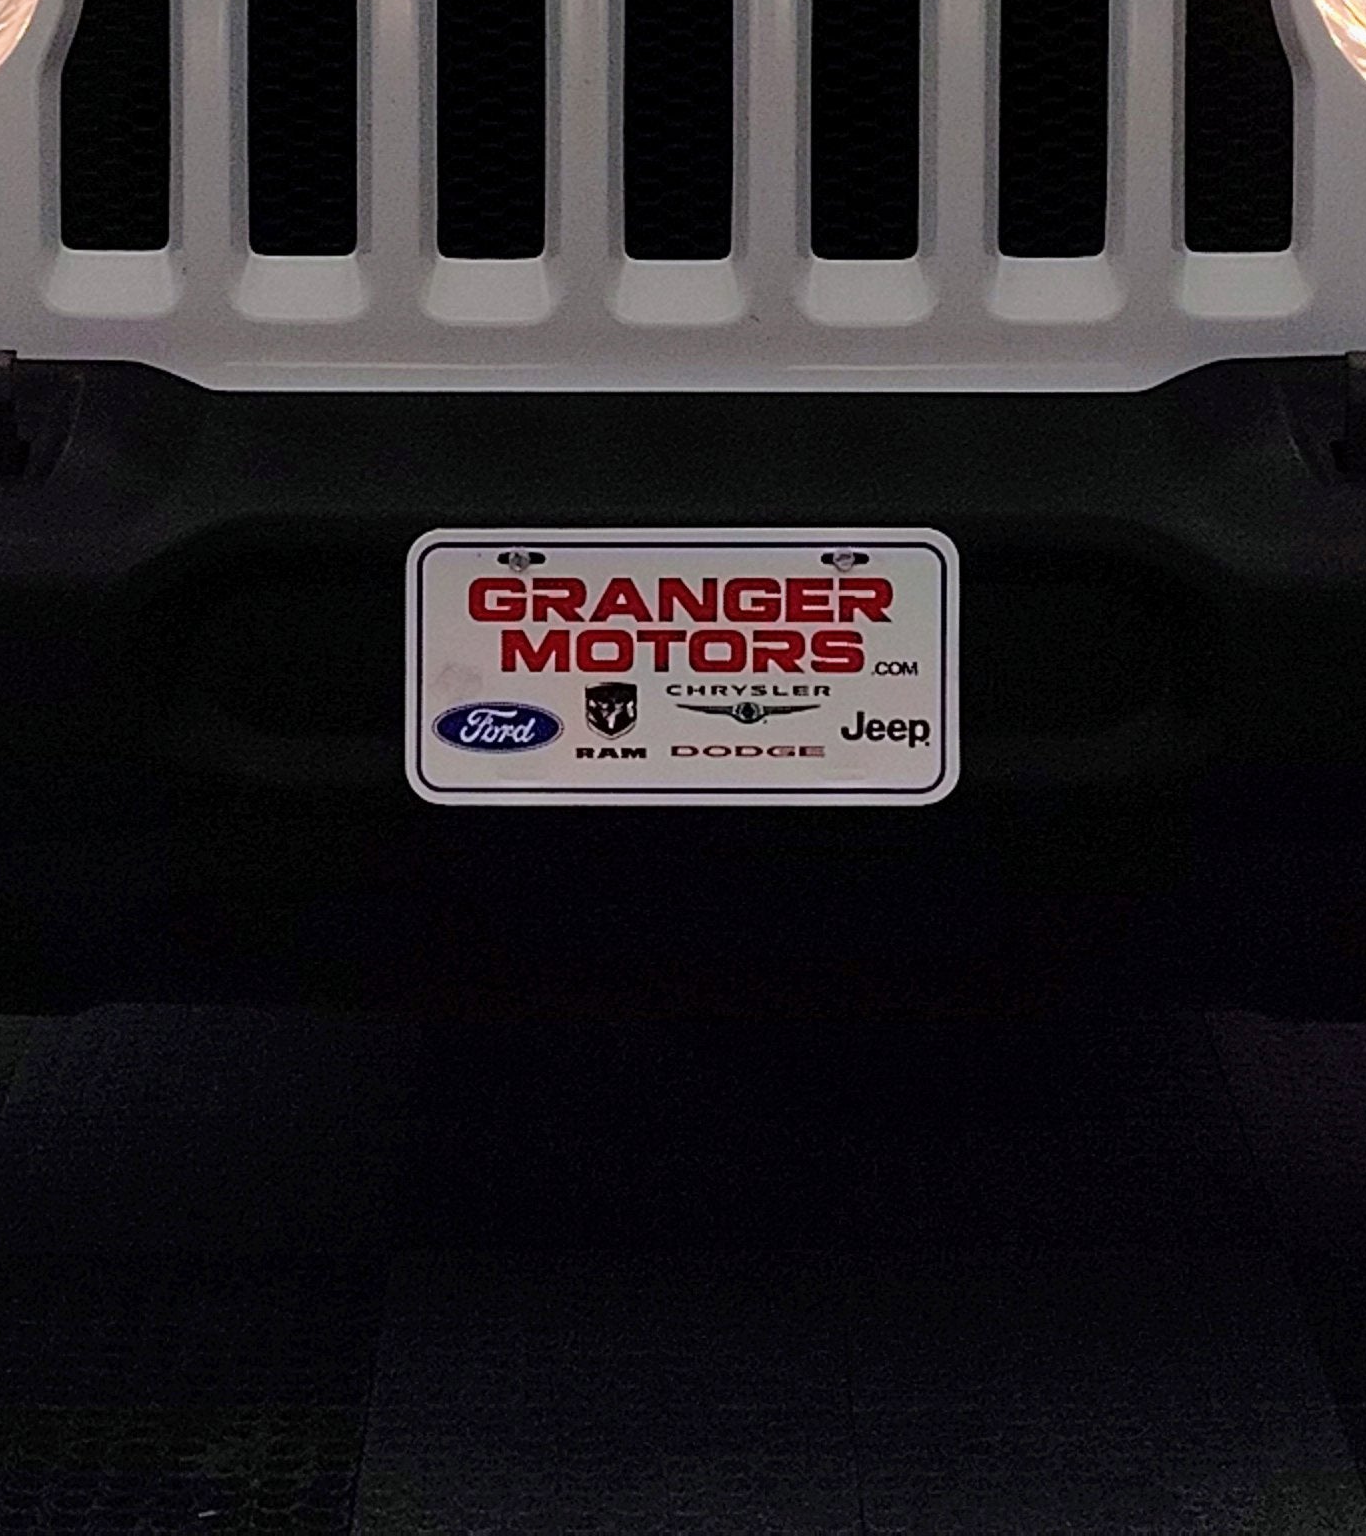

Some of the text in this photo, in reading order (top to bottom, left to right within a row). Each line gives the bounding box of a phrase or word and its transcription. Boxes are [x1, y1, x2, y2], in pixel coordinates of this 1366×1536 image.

[468, 577, 893, 622] GRANGER
[501, 630, 919, 676] MOTORS .COM
[666, 684, 831, 697] CHRYSLER
[459, 708, 536, 744] Ford
[841, 711, 930, 748] Jeep
[576, 747, 647, 759] RAM
[671, 745, 825, 758] DODGE
